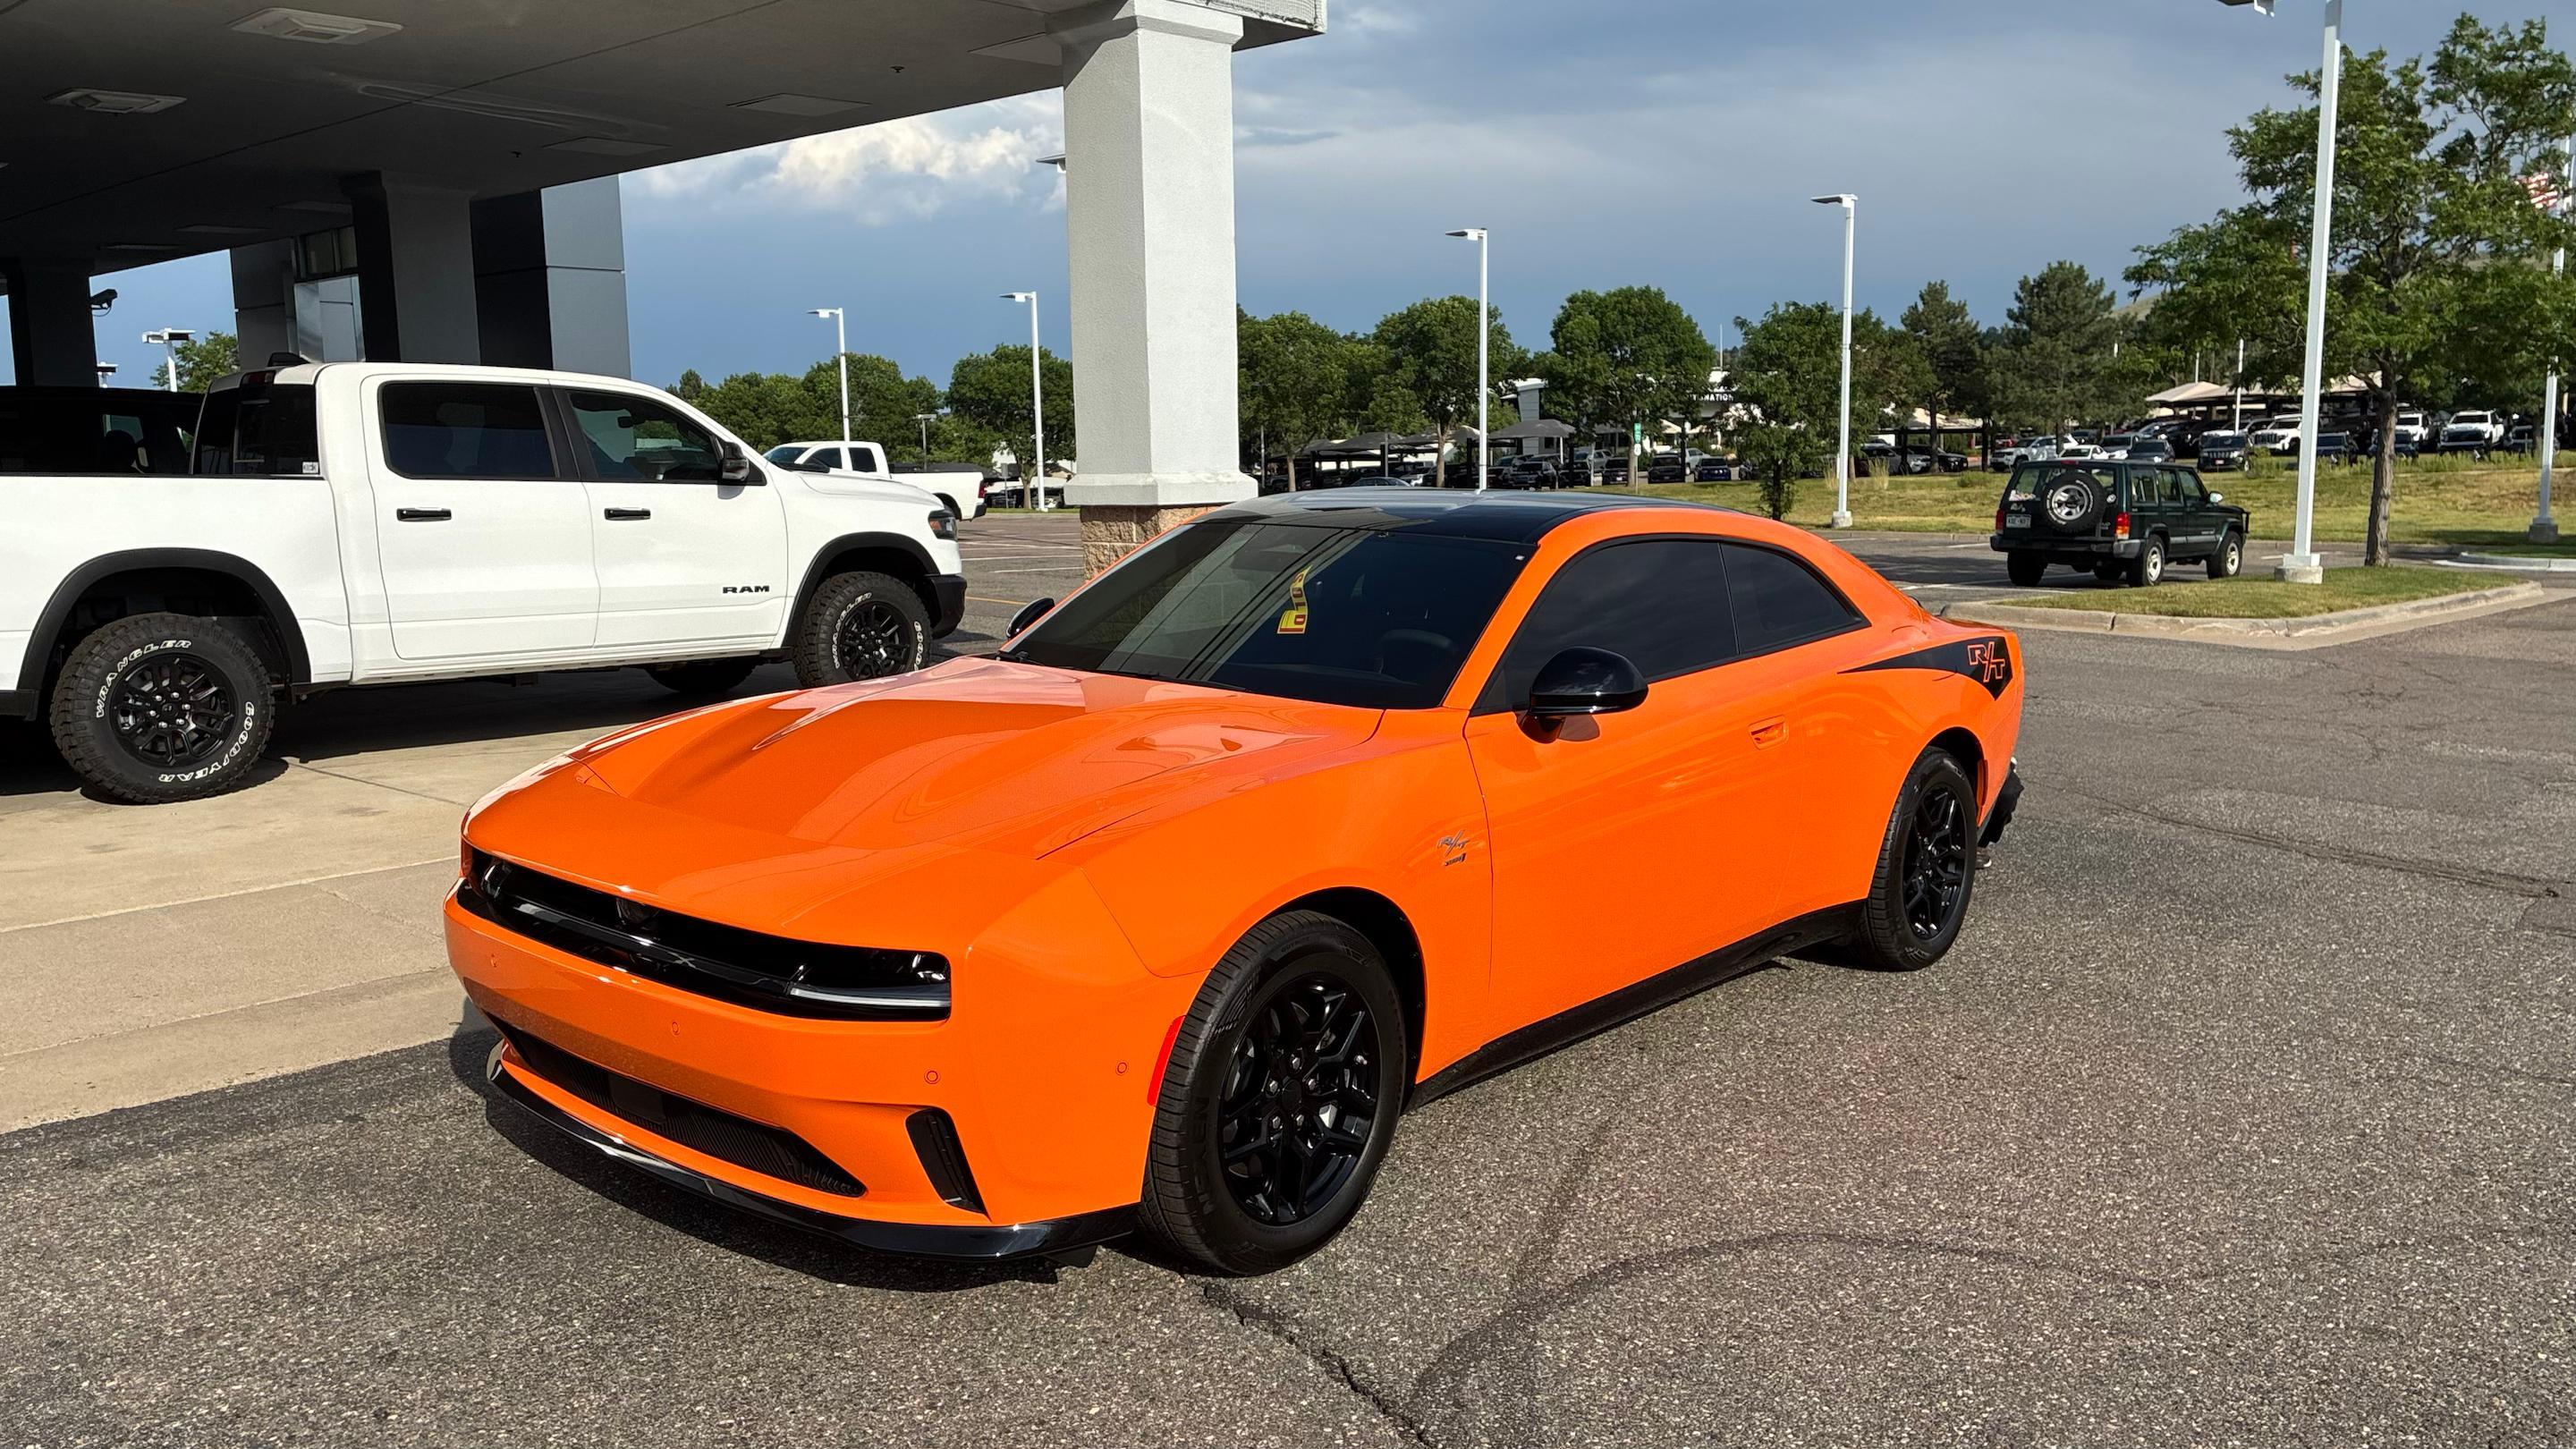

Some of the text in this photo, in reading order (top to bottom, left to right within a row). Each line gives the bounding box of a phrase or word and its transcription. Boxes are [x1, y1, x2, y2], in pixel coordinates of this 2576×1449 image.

[723, 586, 769, 594] RAM
[96, 640, 191, 718] WRANGLER
[1968, 641, 2005, 682] R/T
[158, 701, 255, 783] GOODYEAR
